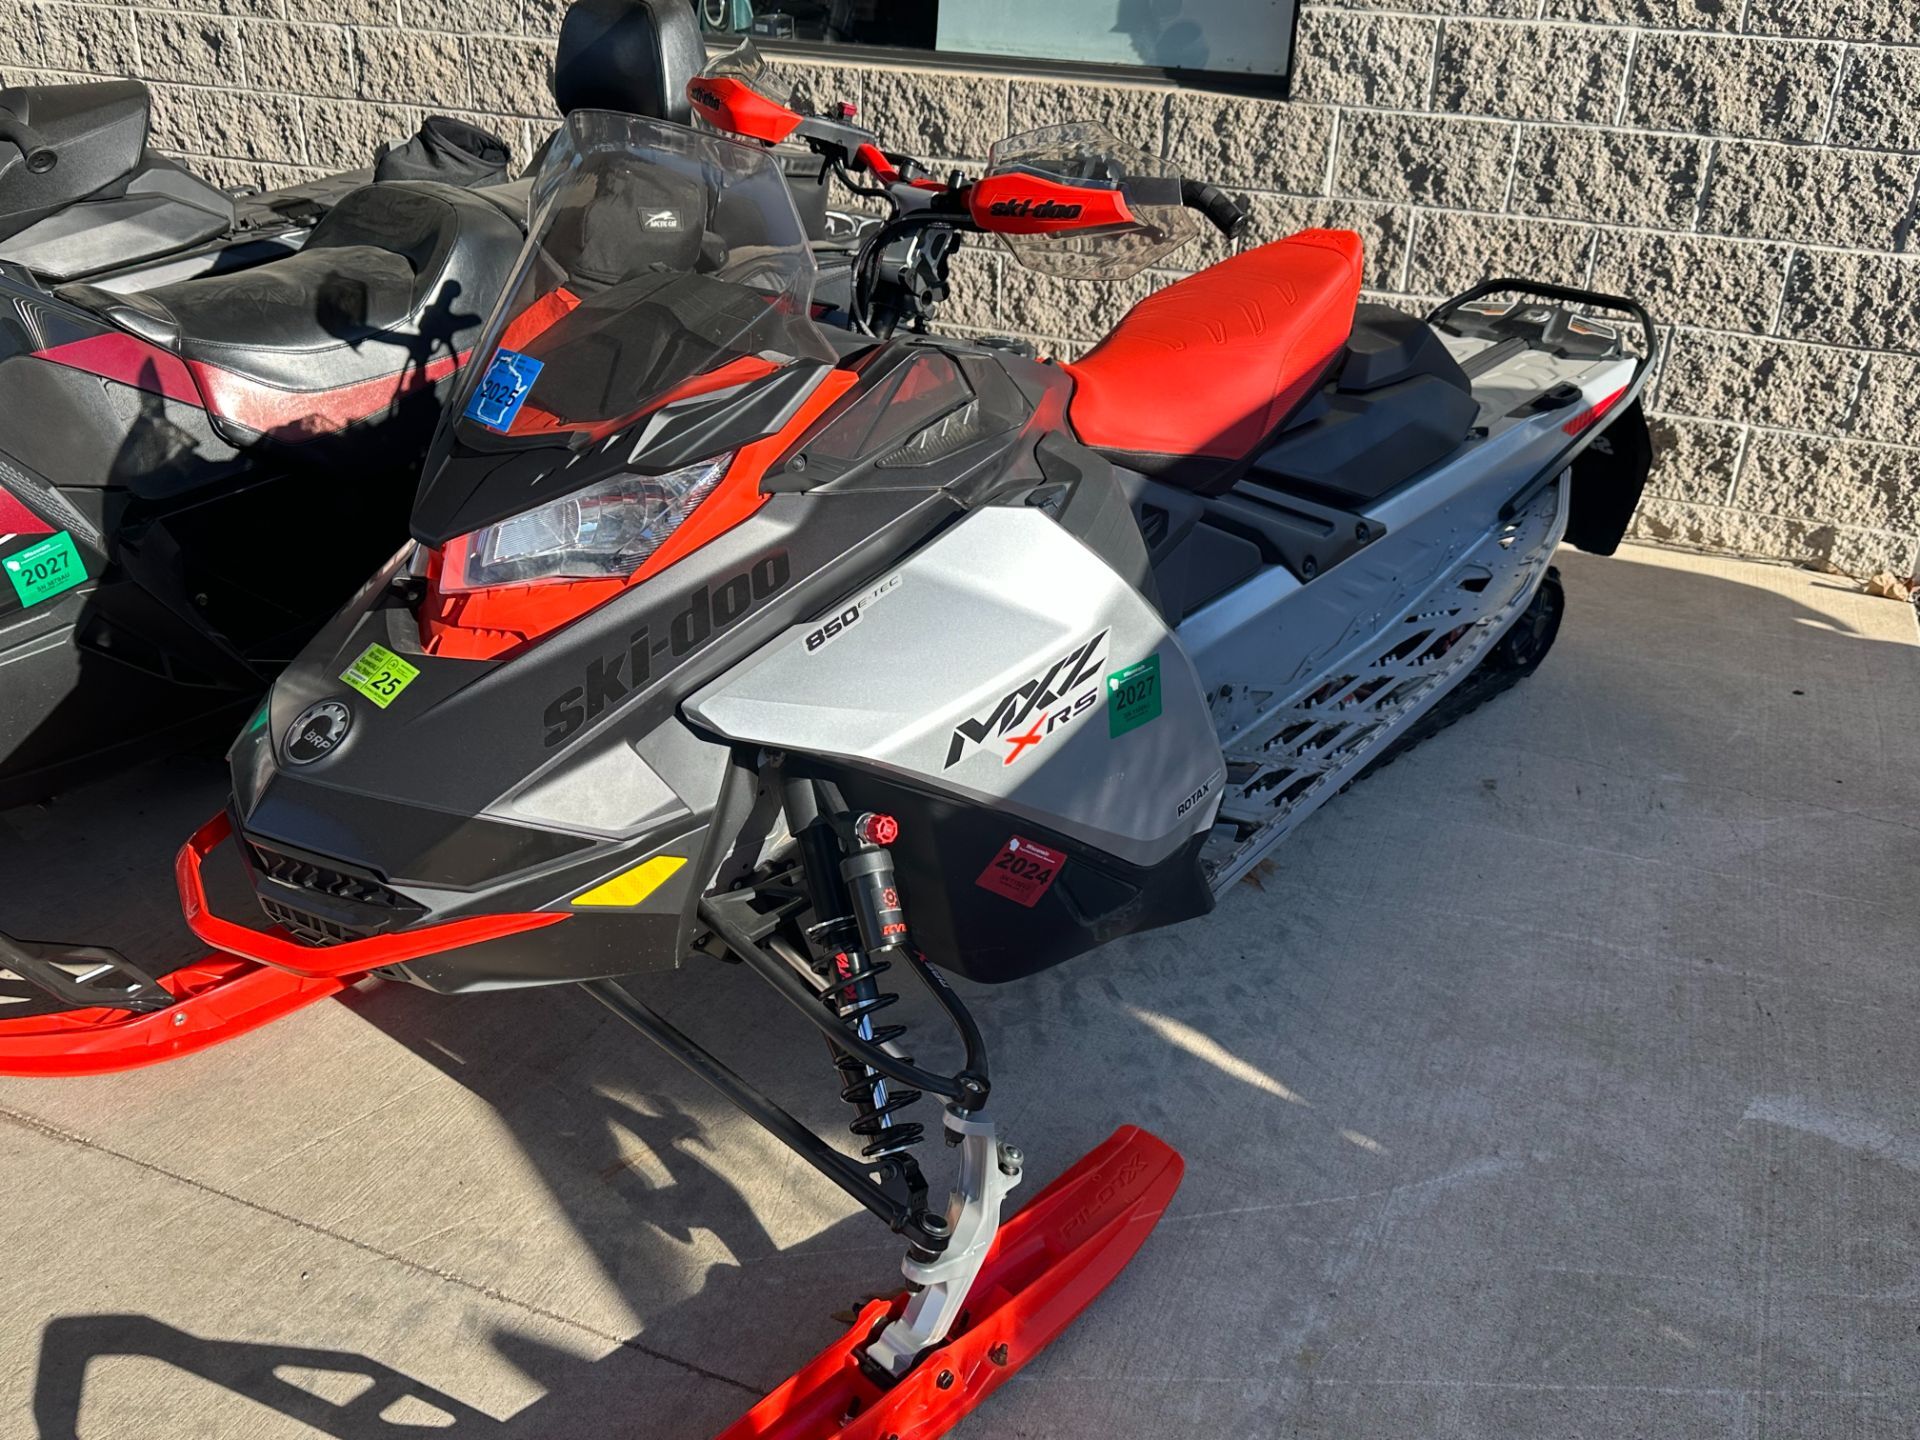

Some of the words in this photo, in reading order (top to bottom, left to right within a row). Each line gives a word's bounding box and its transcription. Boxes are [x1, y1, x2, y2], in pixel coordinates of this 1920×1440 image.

[991, 198, 1082, 219] ski-doo
[480, 380, 520, 407] 2025
[21, 550, 69, 588] 2027
[805, 605, 859, 651] 850
[857, 575, 899, 609] E-TEC
[543, 549, 791, 748] ski-doo
[371, 671, 402, 696] 25
[943, 627, 1110, 770] MXZ
[1116, 674, 1155, 711] 2027
[304, 730, 332, 749] BRP
[1177, 781, 1210, 818] ROTAX
[995, 852, 1053, 886] 2024
